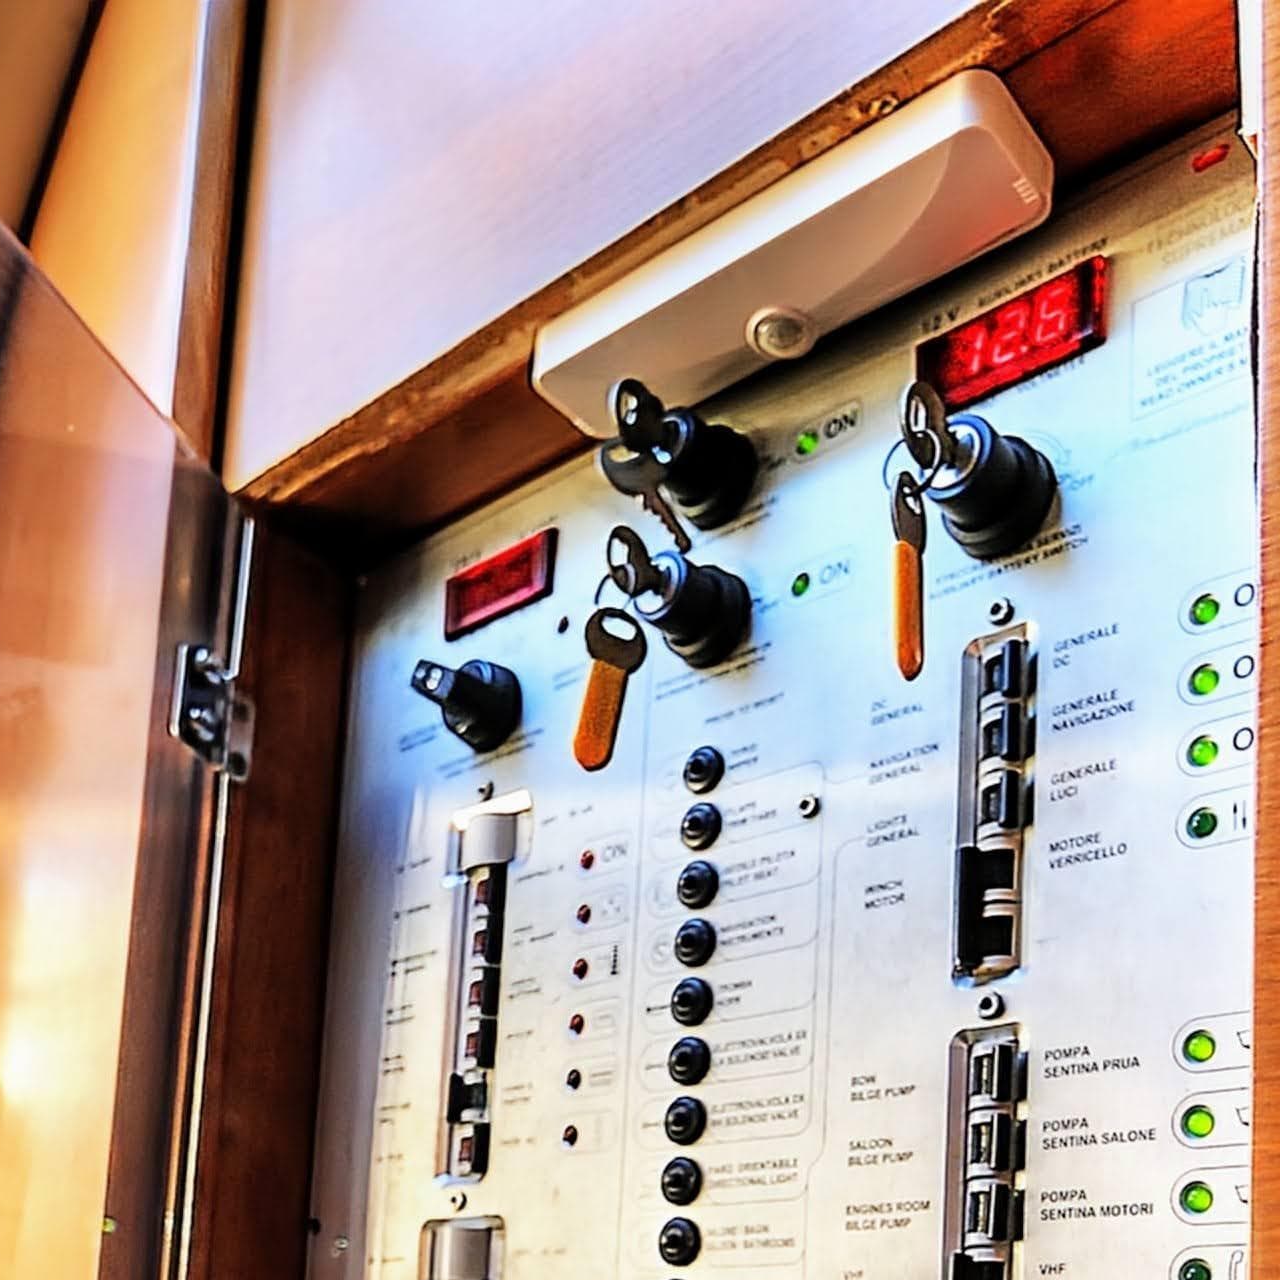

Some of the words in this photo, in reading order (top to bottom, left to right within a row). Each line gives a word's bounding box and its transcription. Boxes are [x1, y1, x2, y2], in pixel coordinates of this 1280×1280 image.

[1047, 236, 1109, 274] BATTERY
[823, 408, 858, 439] ON
[988, 553, 1040, 580] BATTERY
[1041, 536, 1088, 560] SWITCH
[819, 557, 851, 585] ON
[1234, 583, 1255, 607] O
[1053, 622, 1119, 653] GENERALE
[1052, 653, 1070, 669] DC
[1233, 654, 1255, 679] O
[1052, 688, 1118, 717] GENERALE
[1051, 699, 1136, 732] NAVIGAZIONE
[1232, 726, 1255, 751] O
[869, 742, 940, 769] NAVIGATION
[1050, 758, 1117, 786] GENERALE
[1049, 785, 1079, 802] LUCI
[866, 827, 920, 848] GENERAL
[1048, 831, 1101, 853] MOTORE
[1048, 841, 1128, 870] VERRICELLO
[865, 879, 903, 894] WINCH
[865, 892, 905, 910] MOTOR
[1043, 1045, 1091, 1062] POMPA
[1043, 1062, 1100, 1080] SENTINA
[1102, 1056, 1141, 1072] PRUA
[851, 1074, 876, 1088] BOW
[850, 1088, 881, 1102] BILGE
[884, 1083, 916, 1098] PUMP
[1042, 1117, 1089, 1133] POMPA
[849, 1137, 894, 1152] SALOON
[1042, 1133, 1099, 1151] SENTINA
[1101, 1127, 1157, 1146] SALONE
[847, 1153, 879, 1168] BILGE
[881, 1150, 914, 1164] PUMP
[1039, 1188, 1088, 1204] POMPA
[845, 1201, 894, 1217] ENGINES
[895, 1199, 931, 1213] ROOM
[1039, 1205, 1098, 1222] SENTINA
[1099, 1202, 1155, 1218] MOTORI
[844, 1218, 878, 1232] BILGE
[879, 1216, 912, 1230] PUMP
[1038, 1261, 1067, 1276] VHF
